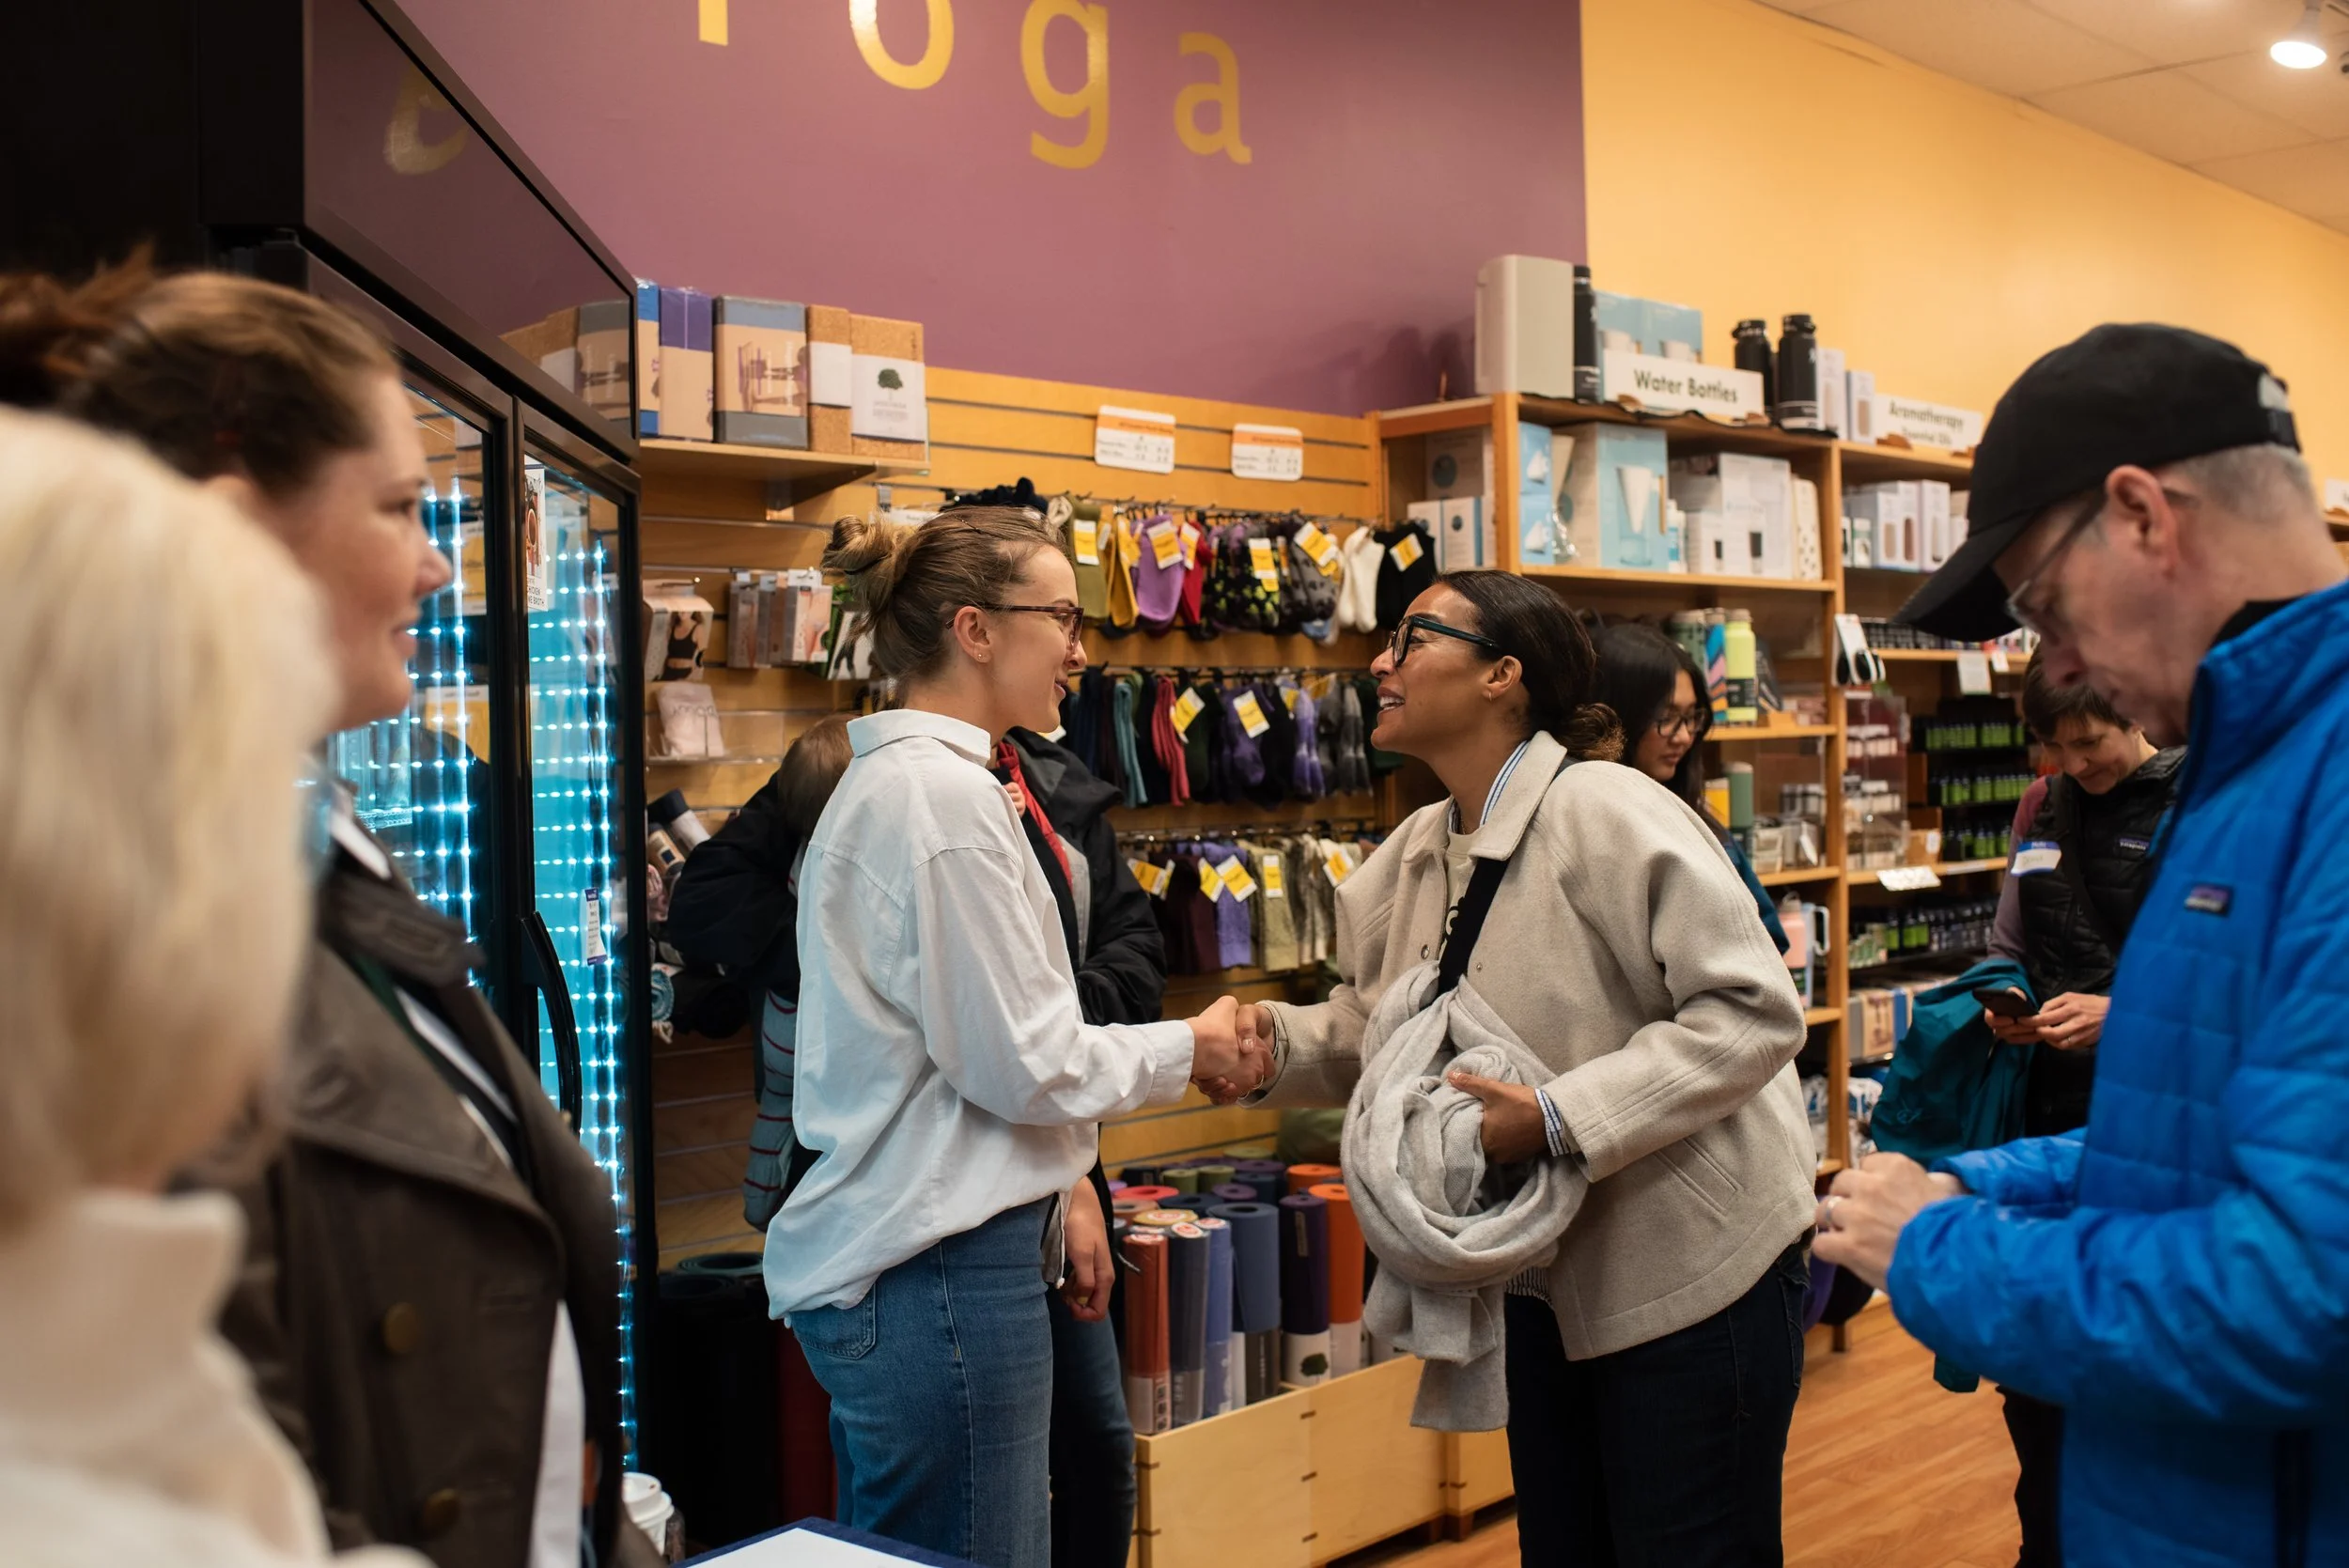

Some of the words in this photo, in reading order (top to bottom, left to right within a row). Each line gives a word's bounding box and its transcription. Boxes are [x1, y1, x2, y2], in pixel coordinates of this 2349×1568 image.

[698, 0, 1252, 169] oga
[1633, 369, 1683, 395] Water
[1688, 378, 1737, 404] Bottles
[1889, 398, 1964, 433] Aromatherapy
